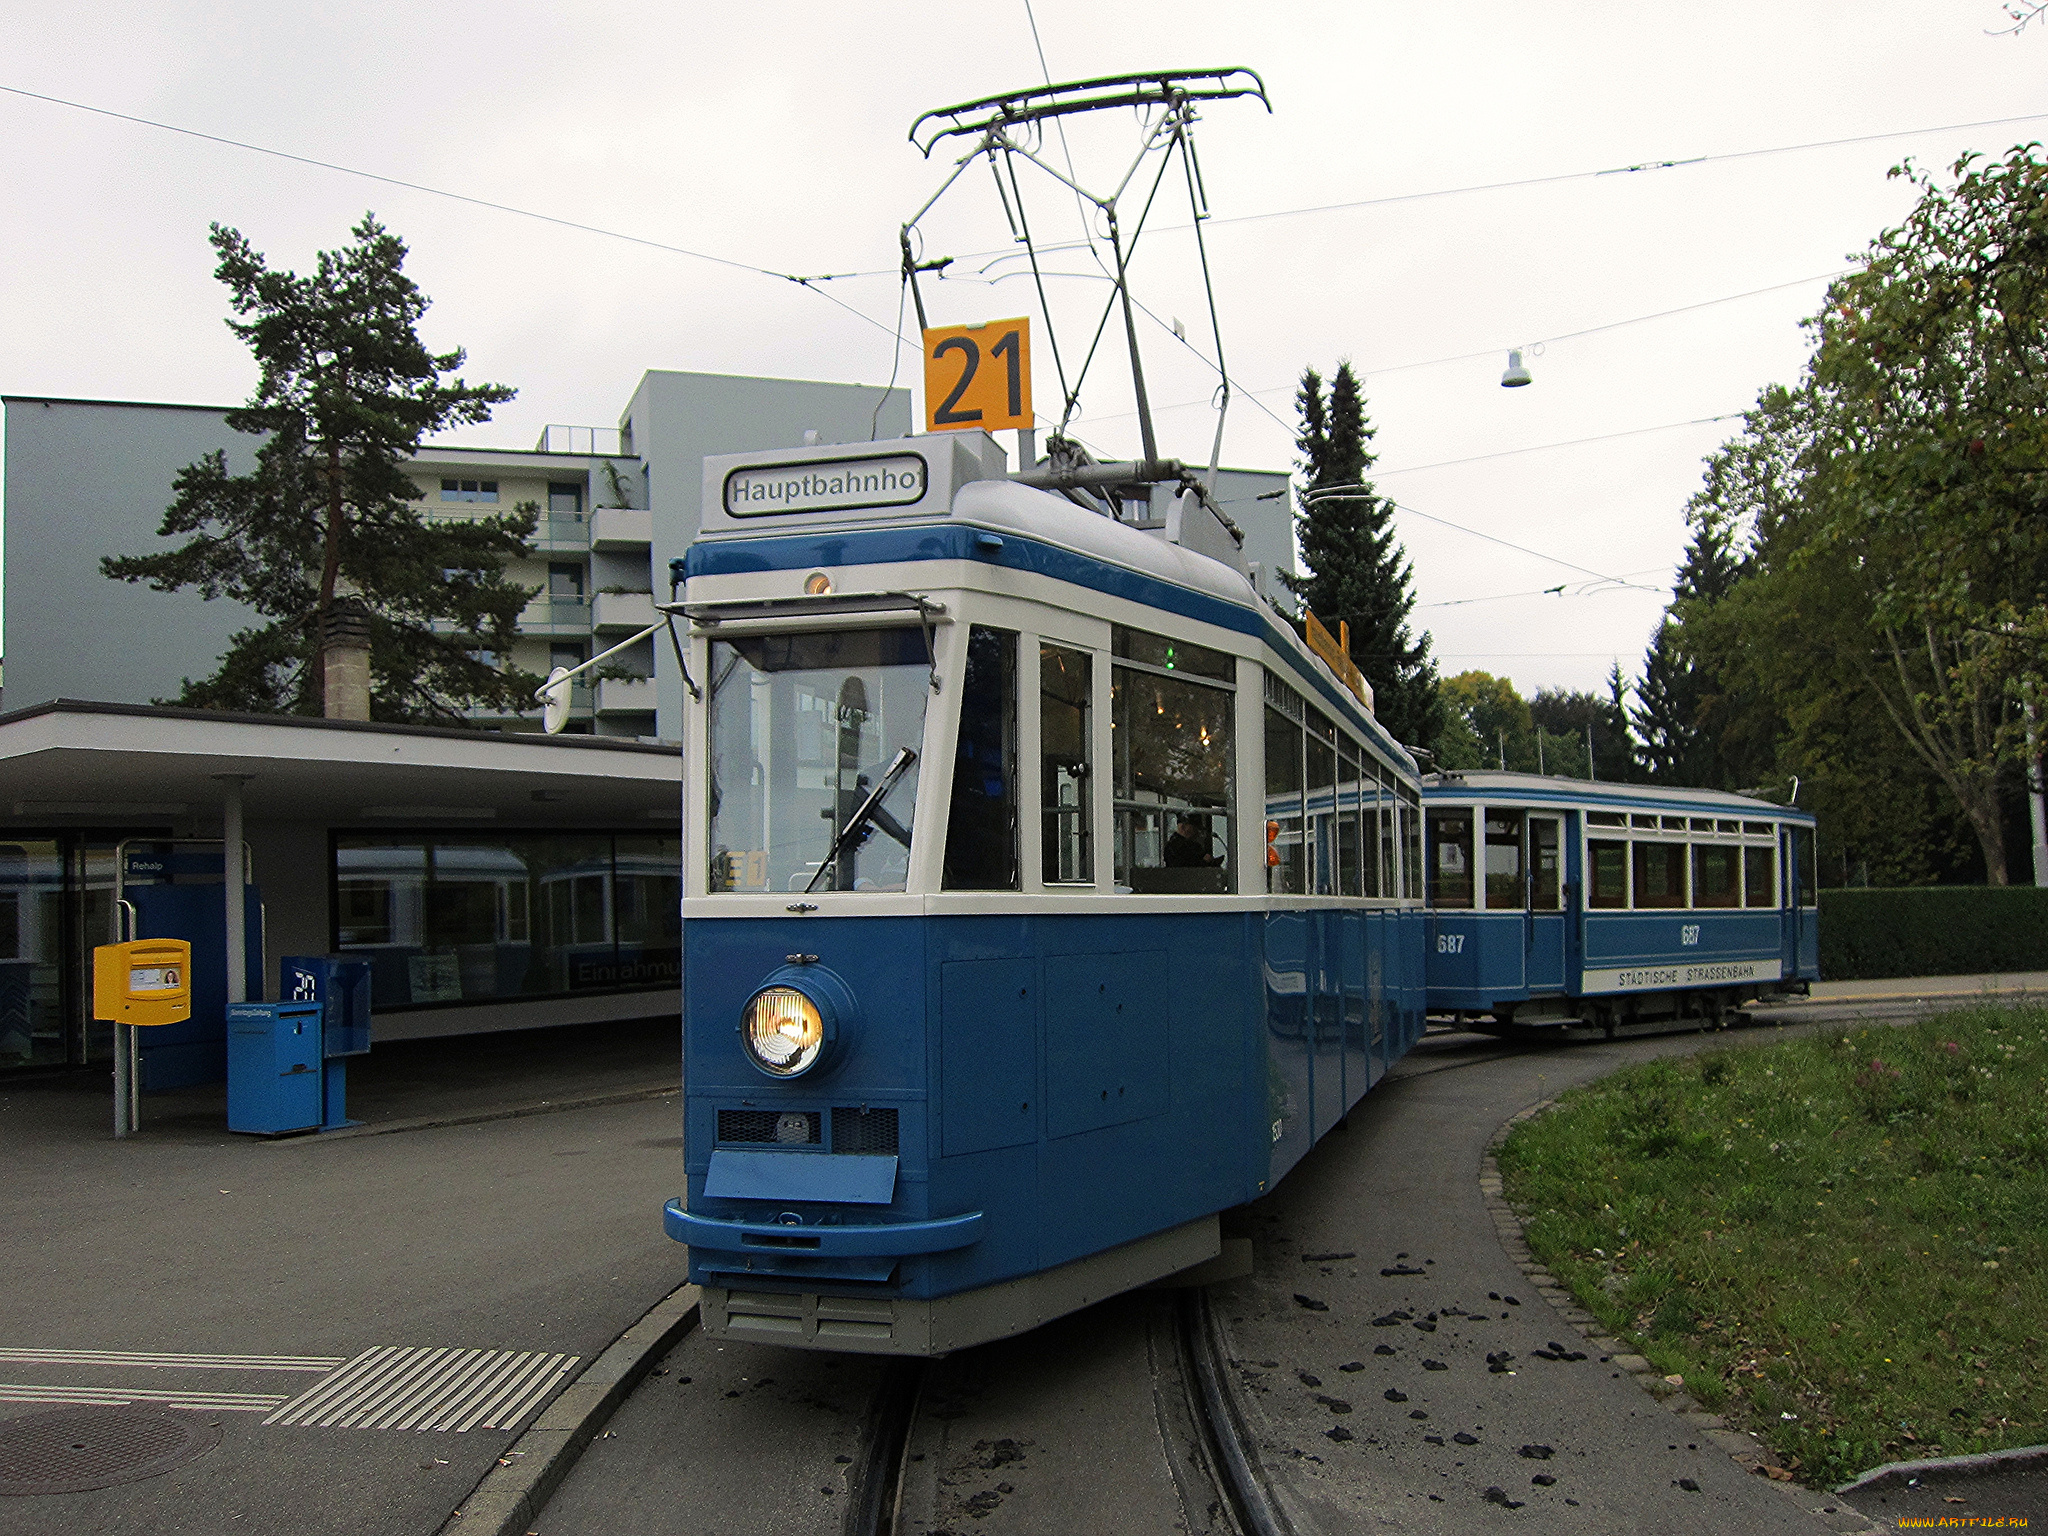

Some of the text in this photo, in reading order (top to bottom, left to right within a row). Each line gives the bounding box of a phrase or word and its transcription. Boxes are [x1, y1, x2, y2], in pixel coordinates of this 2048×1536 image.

[933, 330, 1021, 424] 21
[1437, 934, 1465, 953] 687
[1681, 924, 1700, 945] 687
[1687, 965, 1755, 981] STRASSENBAHN
